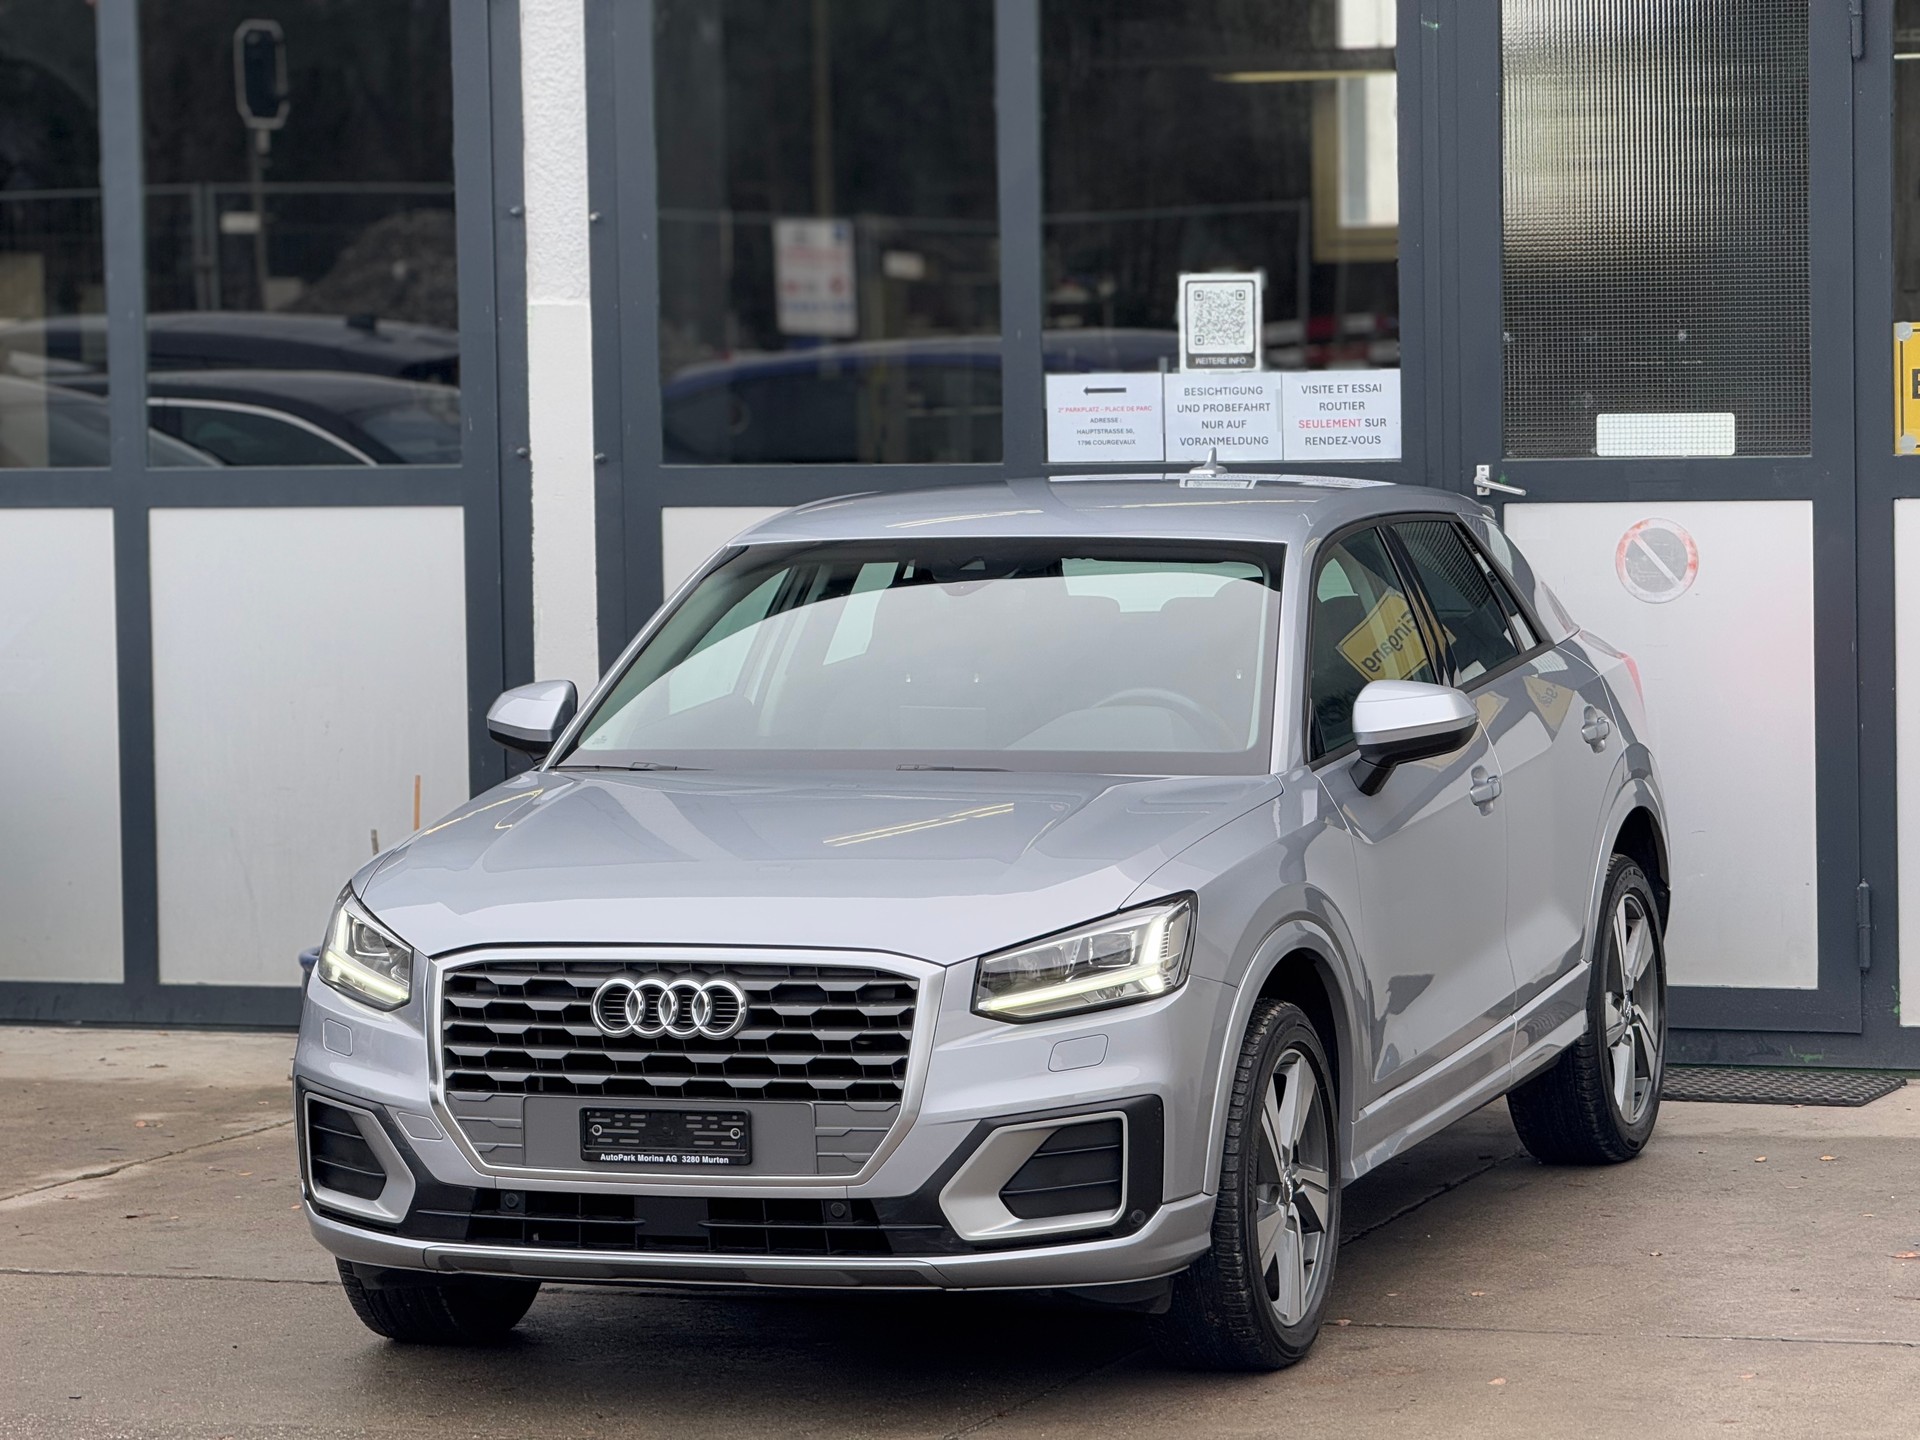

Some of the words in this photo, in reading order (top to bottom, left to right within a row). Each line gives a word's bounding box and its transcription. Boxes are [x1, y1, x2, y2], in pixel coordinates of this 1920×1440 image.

[1195, 357, 1227, 365] WEITERE
[1228, 357, 1247, 365] INFO
[1184, 386, 1264, 396] BESICHTIGUNG
[1301, 385, 1334, 394] VISITE
[1337, 384, 1349, 393] ET
[1351, 383, 1382, 393] ESSAI
[1177, 404, 1200, 413] UND
[1202, 403, 1271, 412] PROBEFAHRT
[1319, 401, 1366, 411] ROUTIER
[1201, 420, 1224, 429] NUR
[1226, 419, 1247, 429] AUF
[1298, 419, 1362, 428] SEULEMENT
[1364, 418, 1387, 427] SUR
[1179, 436, 1269, 446] VORANMELDUNG
[1304, 435, 1382, 446] RENDEZ-VOUS
[600, 1153, 636, 1162] AutoPark
[665, 1155, 678, 1163] AG
[681, 1155, 700, 1163] 3280
[701, 1156, 729, 1164] Murten
